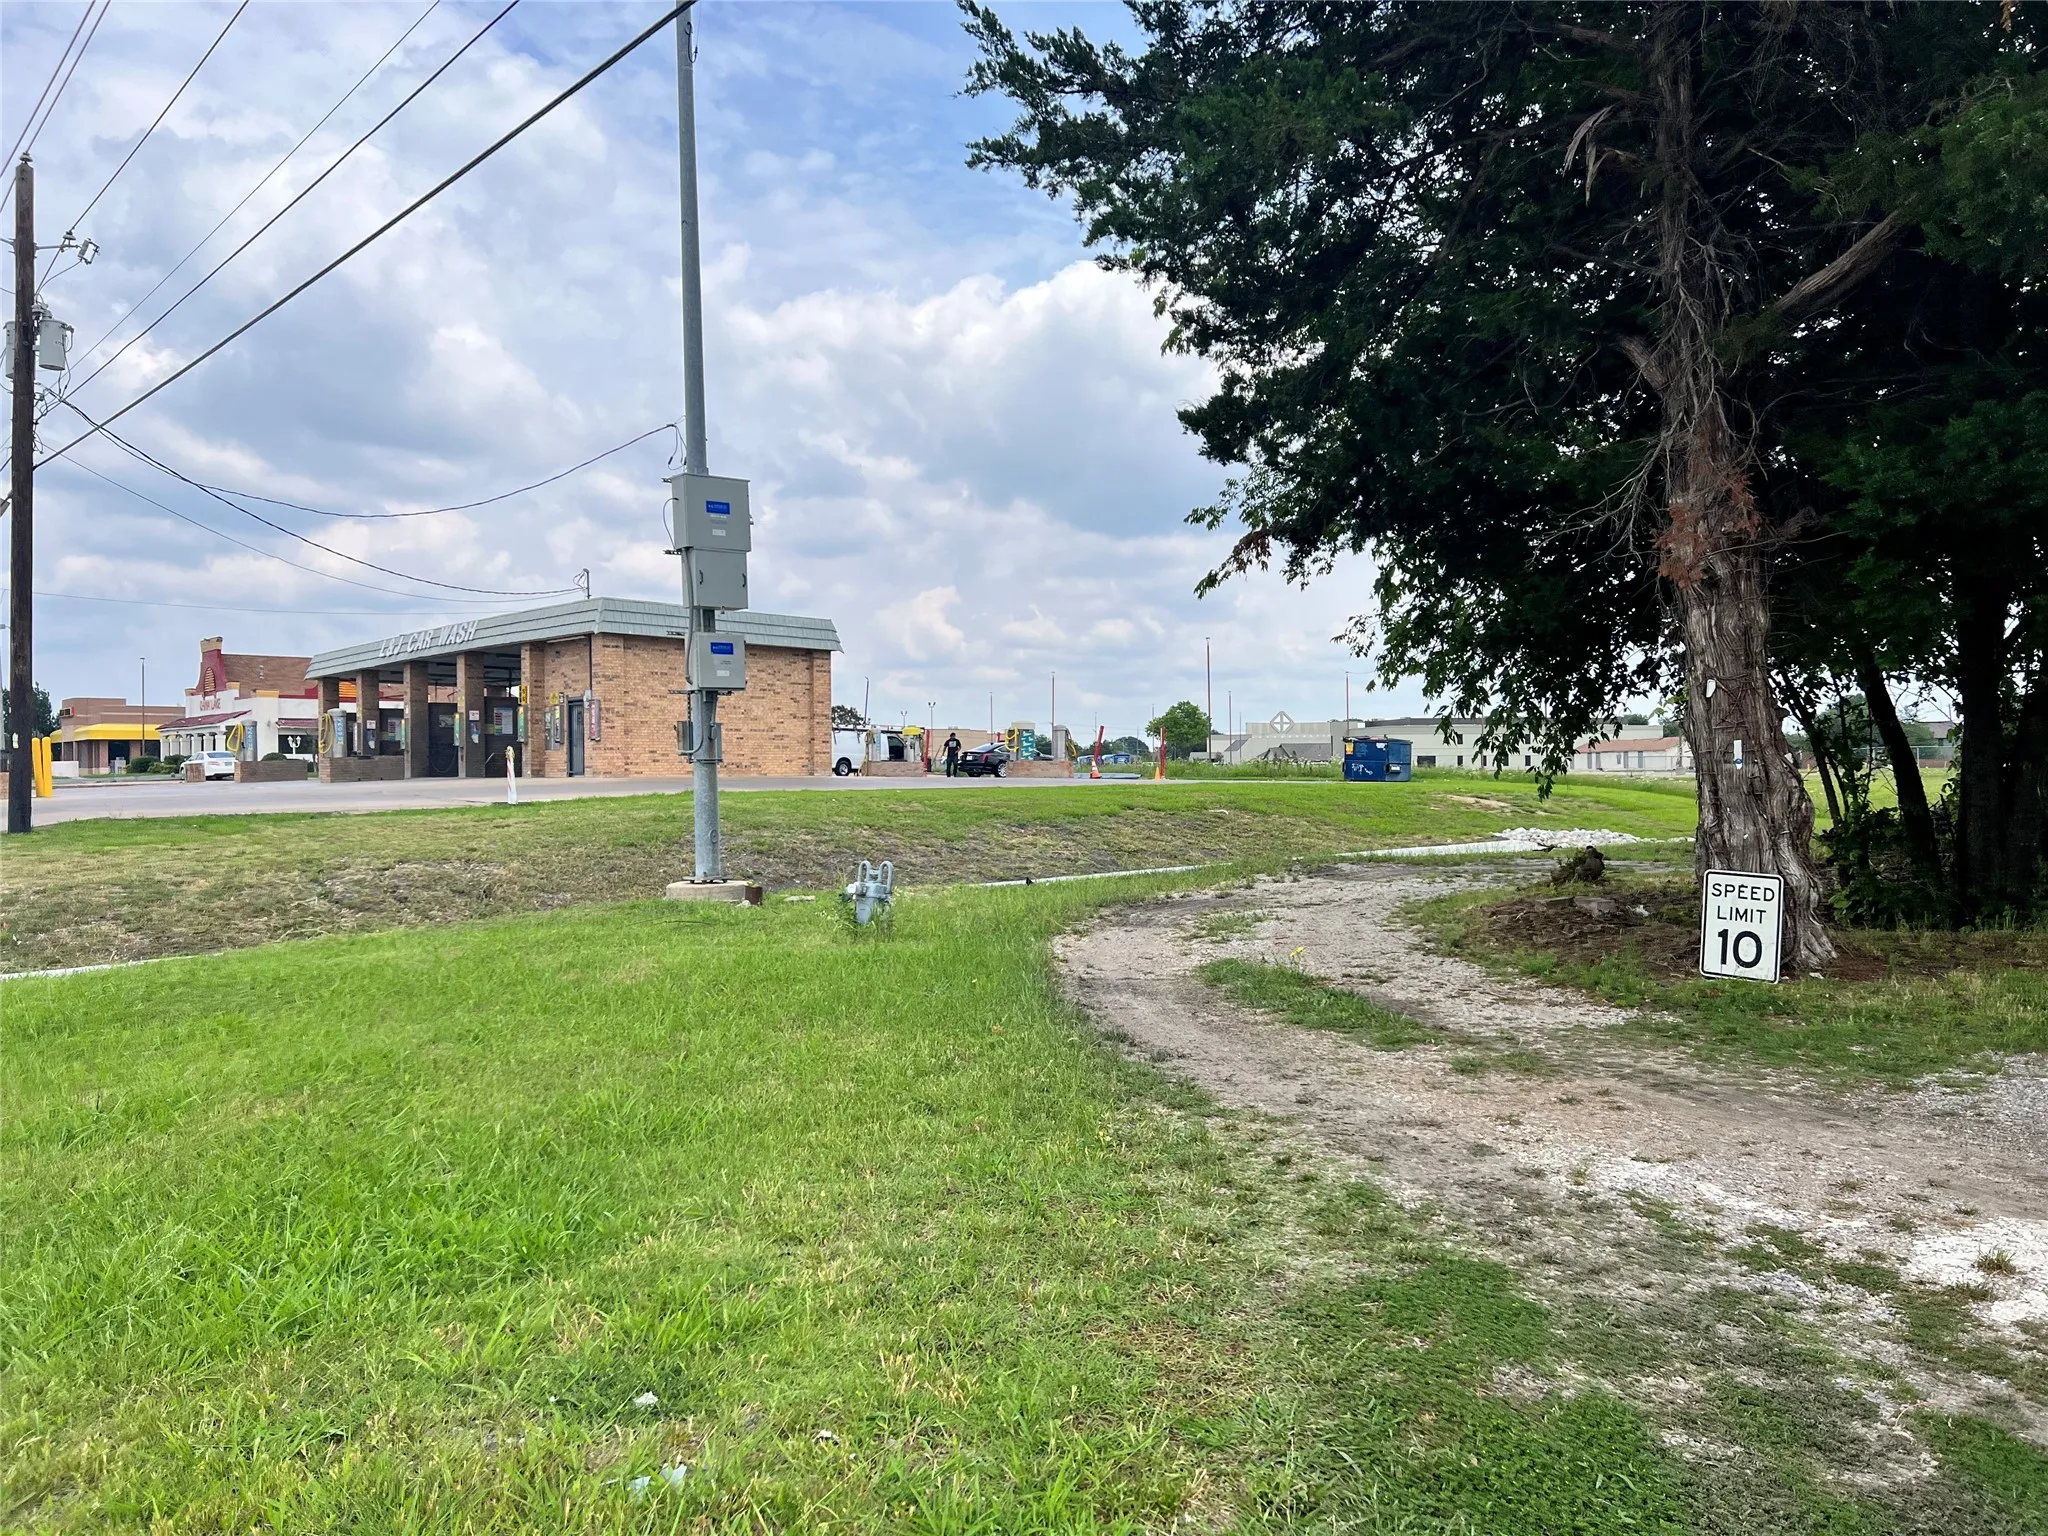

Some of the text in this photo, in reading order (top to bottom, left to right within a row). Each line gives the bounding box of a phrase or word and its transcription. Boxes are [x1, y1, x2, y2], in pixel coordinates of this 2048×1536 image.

[379, 620, 478, 657] L&J CAR WASH
[1711, 883, 1775, 902] SPEED
[1717, 905, 1767, 924] LIMIT
[1717, 928, 1763, 969] 10
